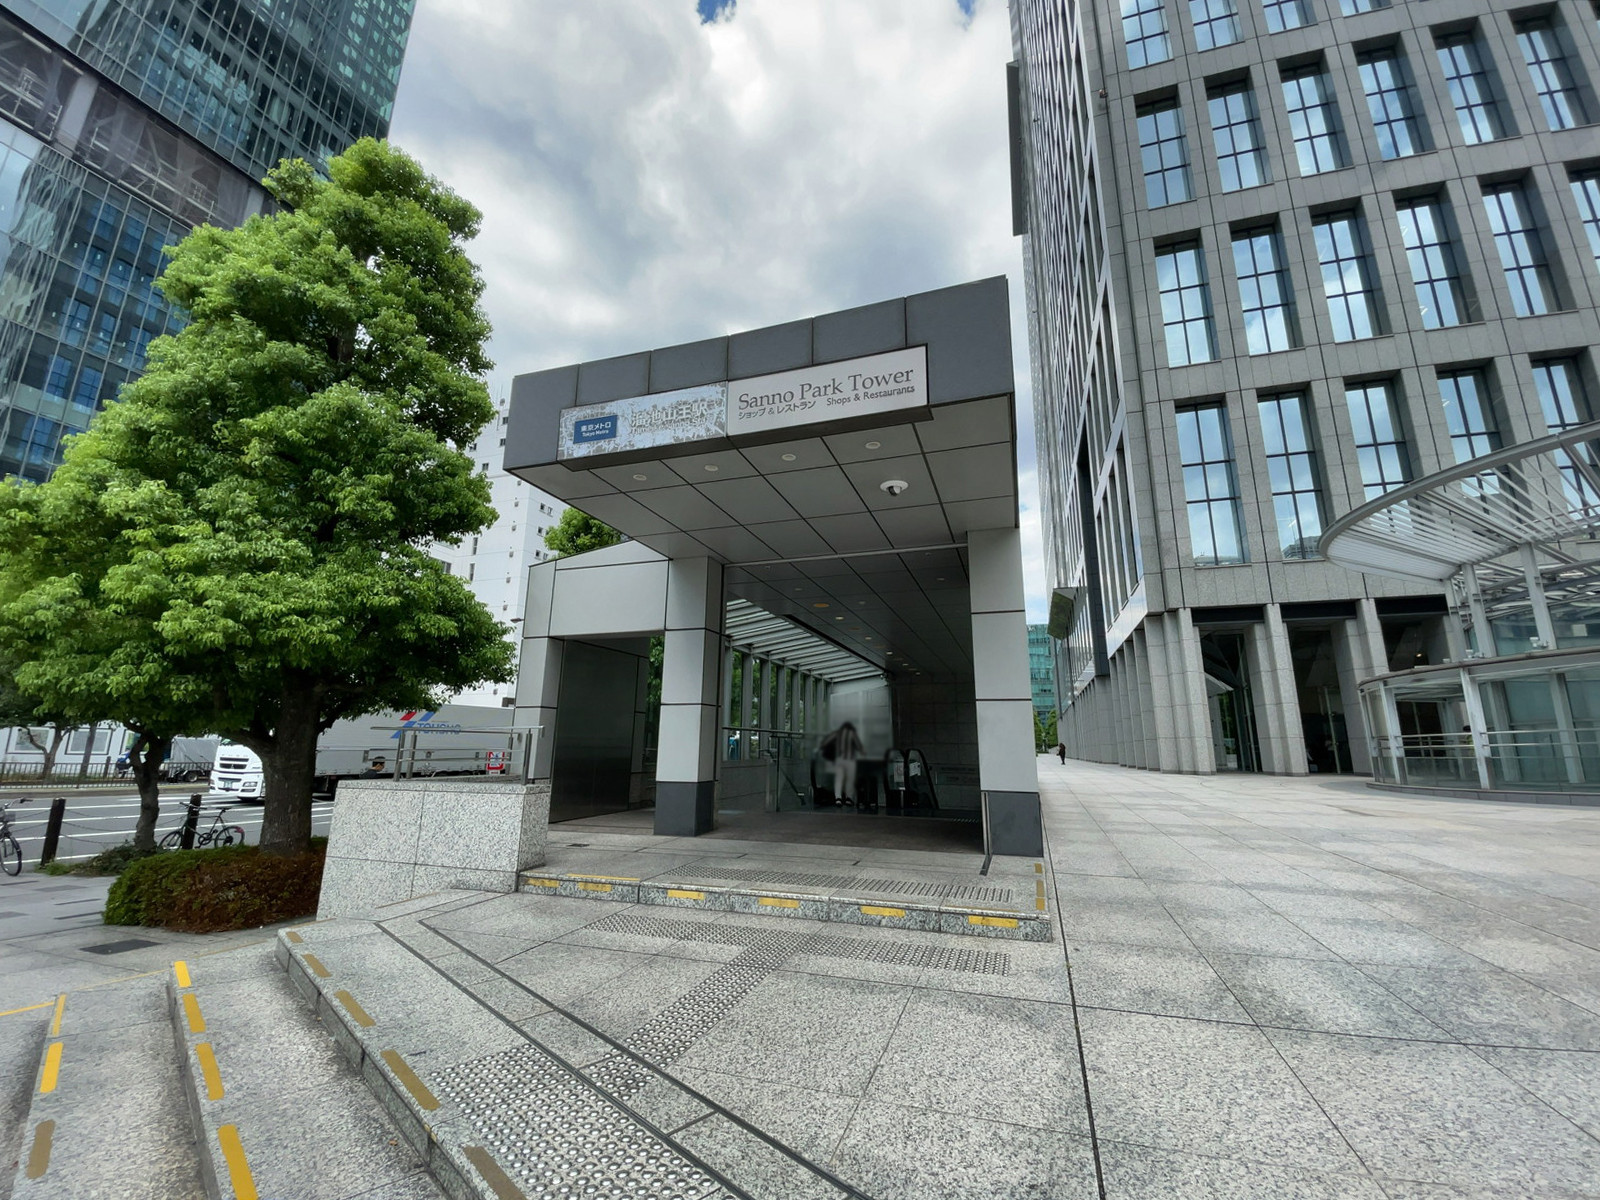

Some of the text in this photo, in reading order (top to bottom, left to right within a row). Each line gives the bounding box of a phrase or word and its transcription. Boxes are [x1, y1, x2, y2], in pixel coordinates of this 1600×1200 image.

[738, 369, 914, 410] Sanno Park Tower
[826, 385, 915, 407] Shops & Restaurants
[580, 421, 612, 432] 東京メトロ
